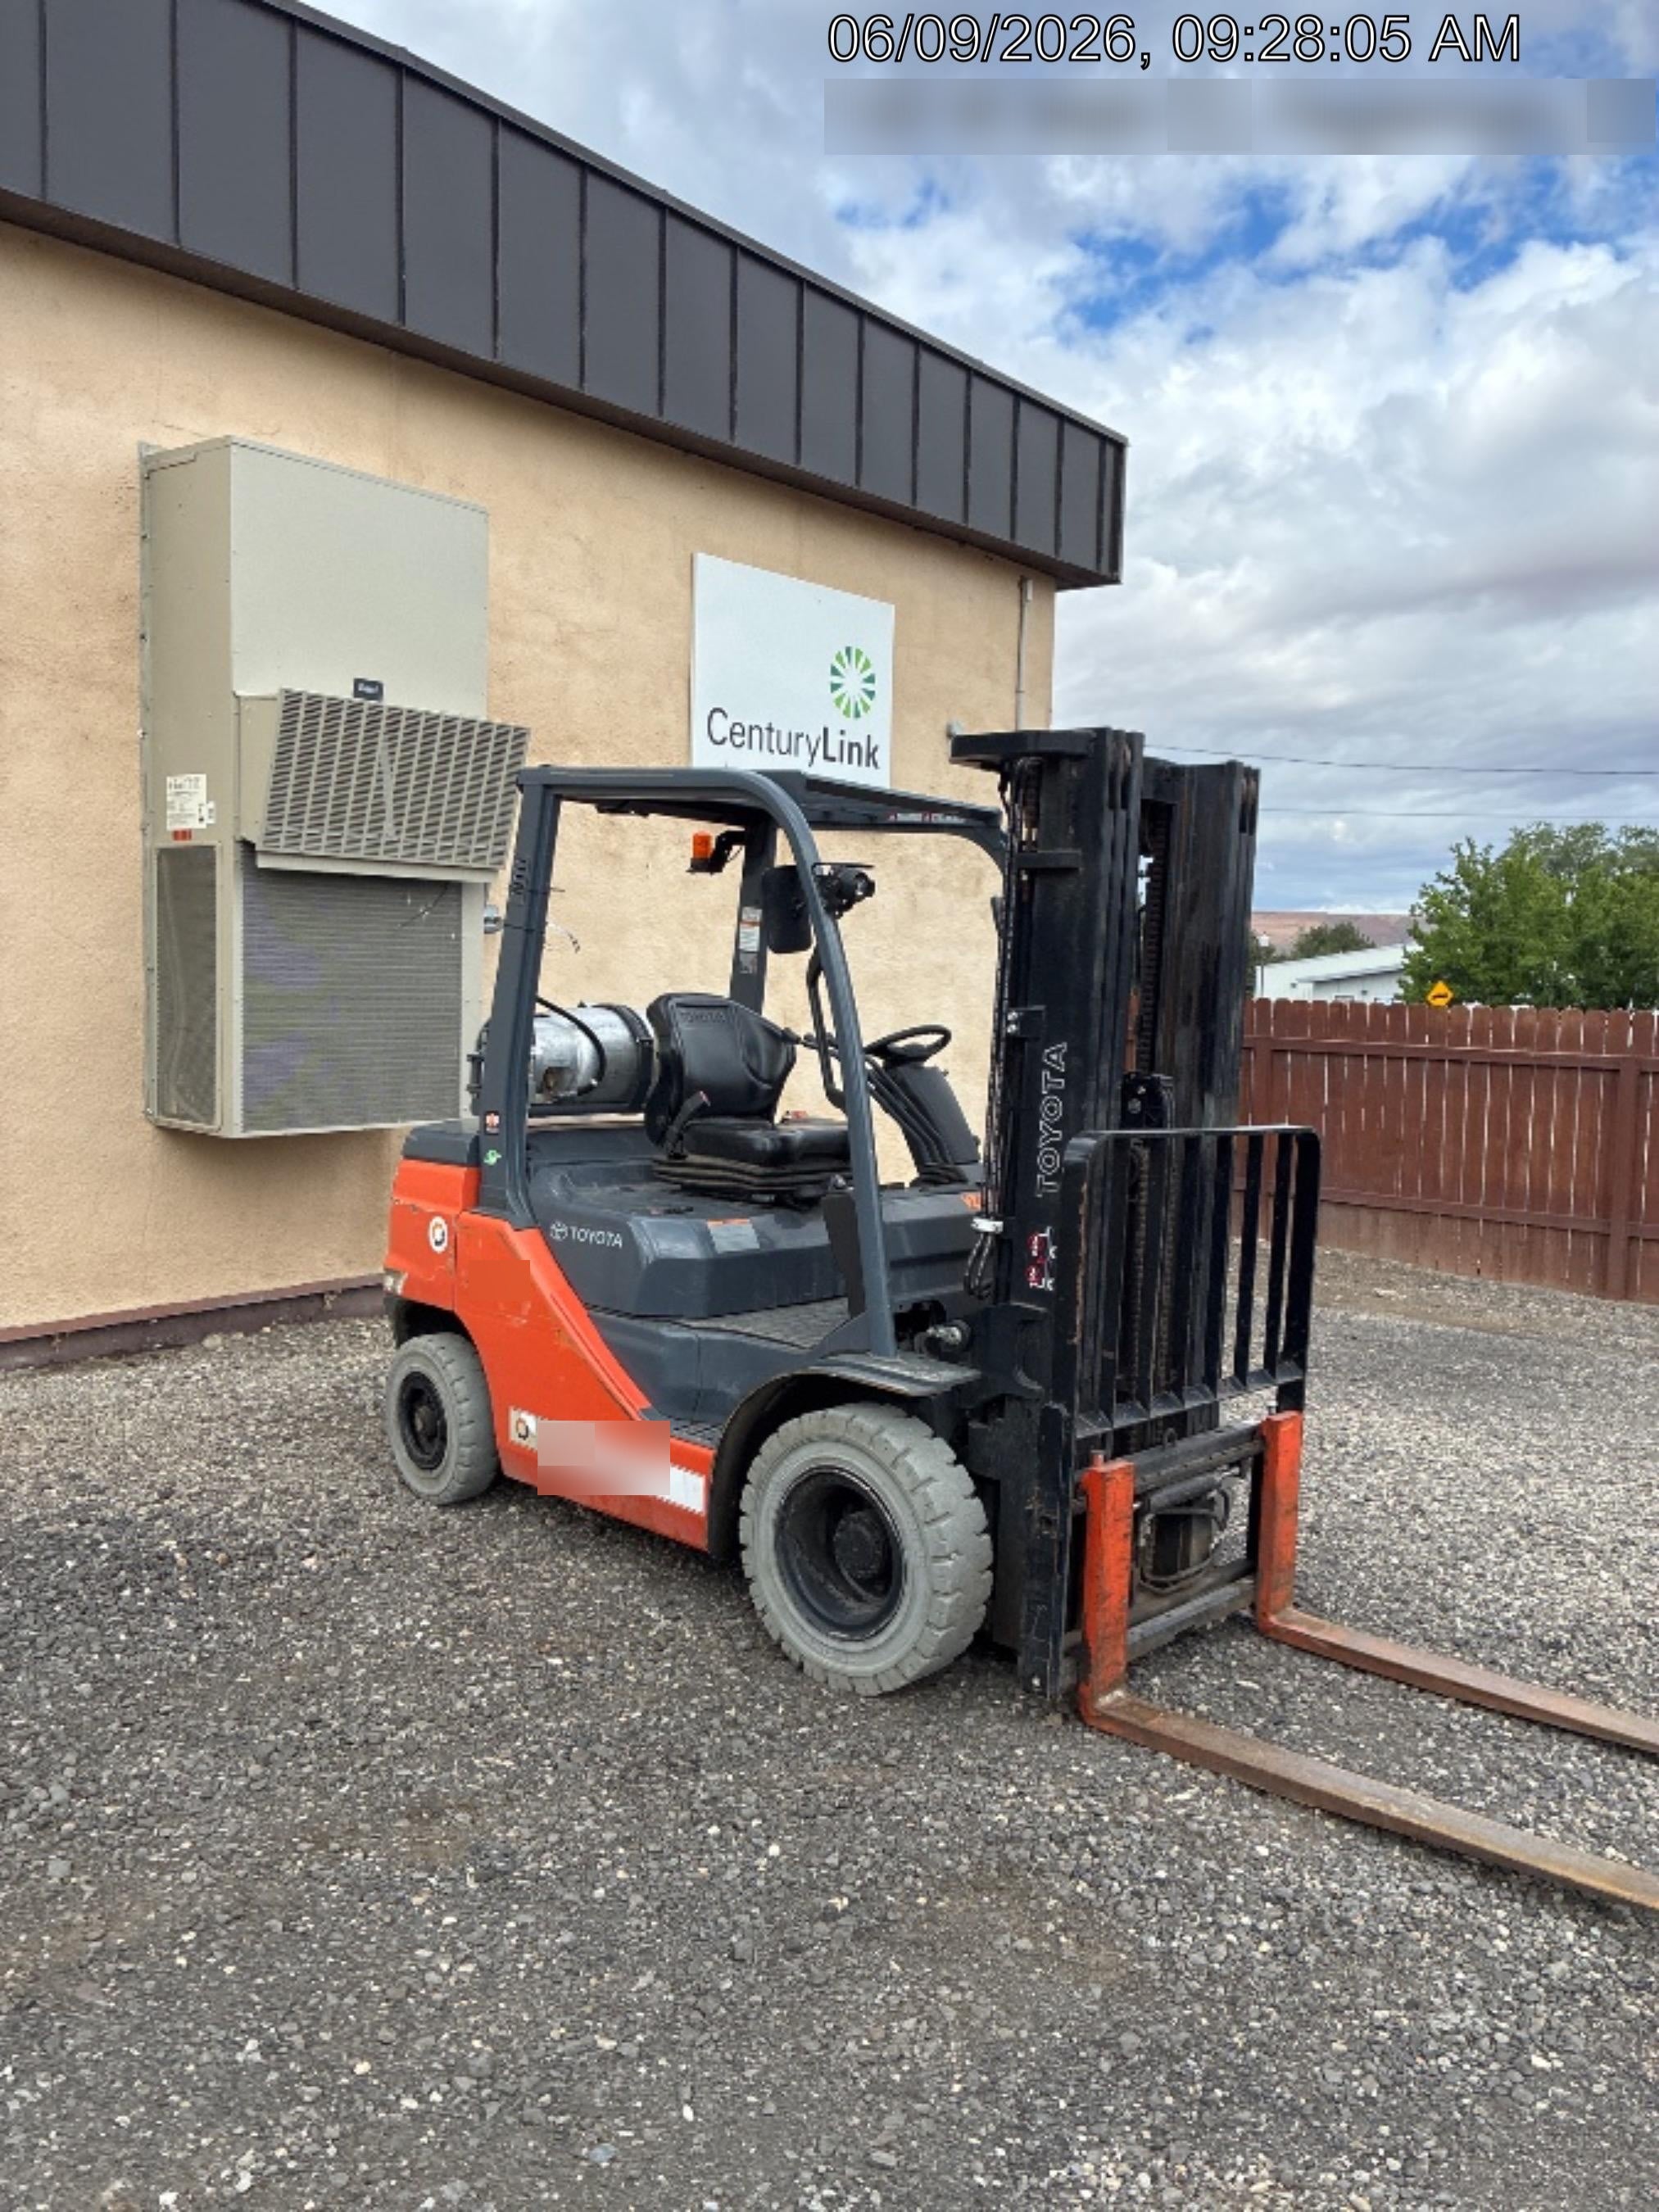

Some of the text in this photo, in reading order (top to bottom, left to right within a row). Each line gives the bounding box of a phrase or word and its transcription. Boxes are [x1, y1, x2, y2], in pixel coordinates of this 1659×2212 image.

[707, 707, 879, 769] CenturyLink
[1036, 1041, 1067, 1198] TOYOTA
[569, 1226, 623, 1249] TOYOTA
